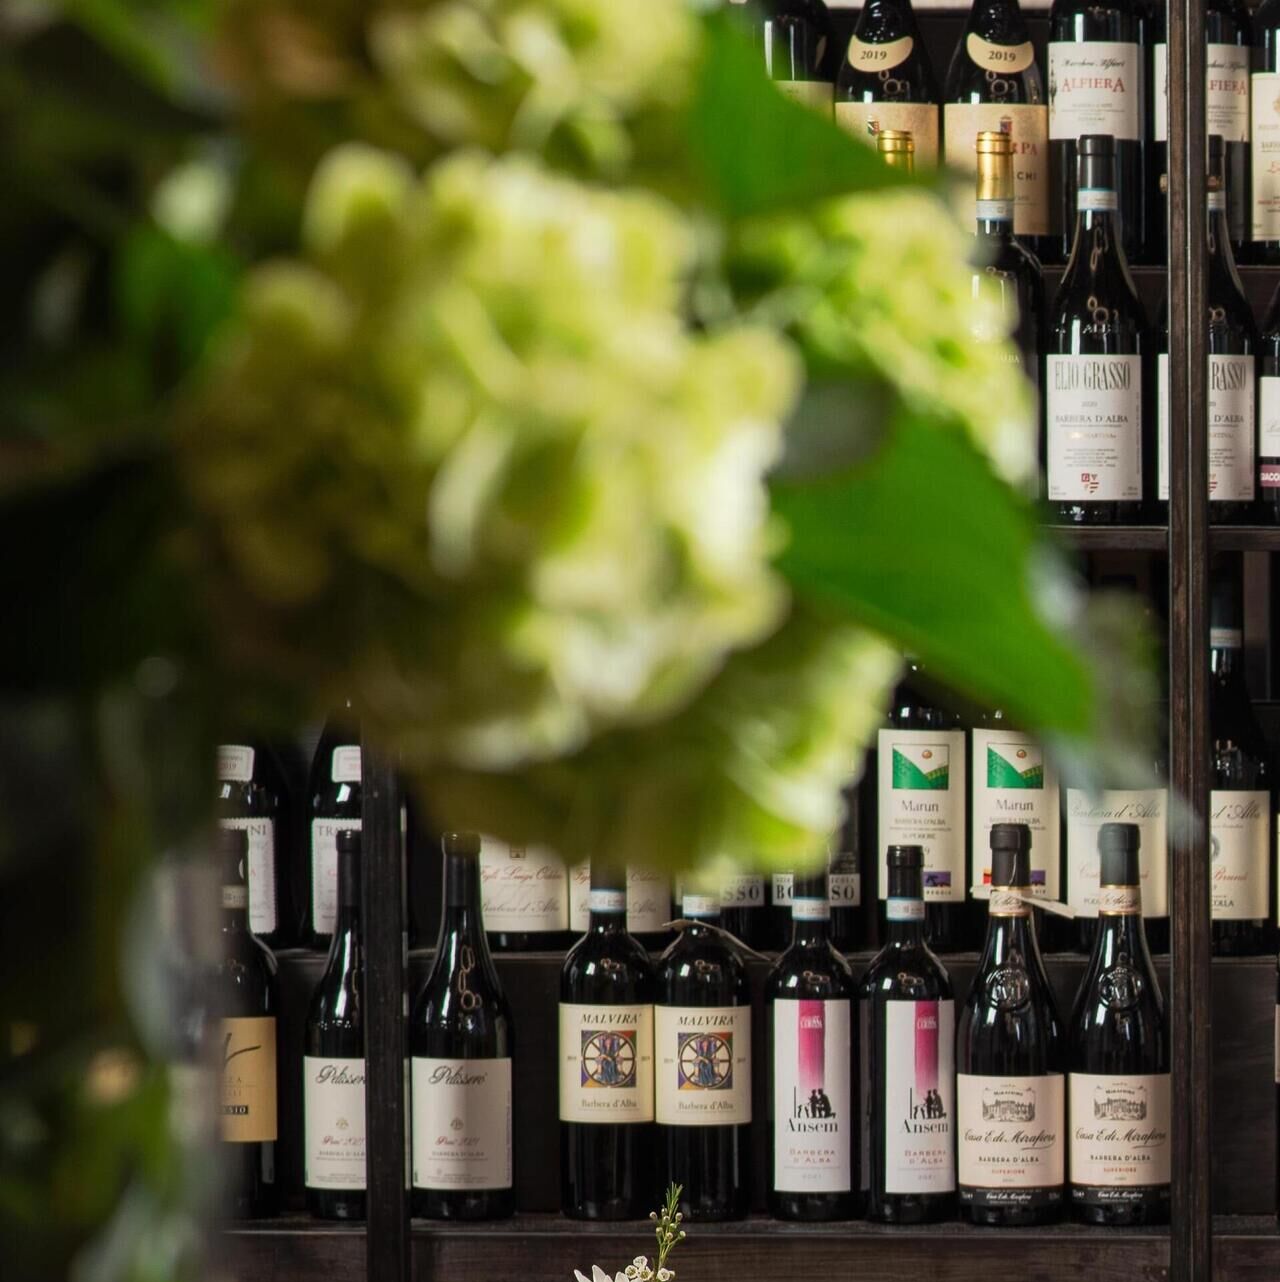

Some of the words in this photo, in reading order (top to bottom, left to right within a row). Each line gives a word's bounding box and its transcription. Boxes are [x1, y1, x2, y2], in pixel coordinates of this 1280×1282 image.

[860, 50, 887, 61] 2019
[988, 50, 1016, 63] 2019
[1062, 77, 1125, 93] ALFIERA
[1055, 362, 1079, 390] ELIO
[1083, 362, 1131, 390] GRASSO
[1212, 362, 1246, 390] RASSO
[1055, 414, 1092, 423] BARBERA
[1095, 414, 1129, 423] D'ALBA
[581, 1099, 611, 1108] Barbera
[612, 1099, 638, 1108] d'Alba
[678, 1101, 709, 1110] Barbera
[709, 1101, 735, 1110] d'Alba
